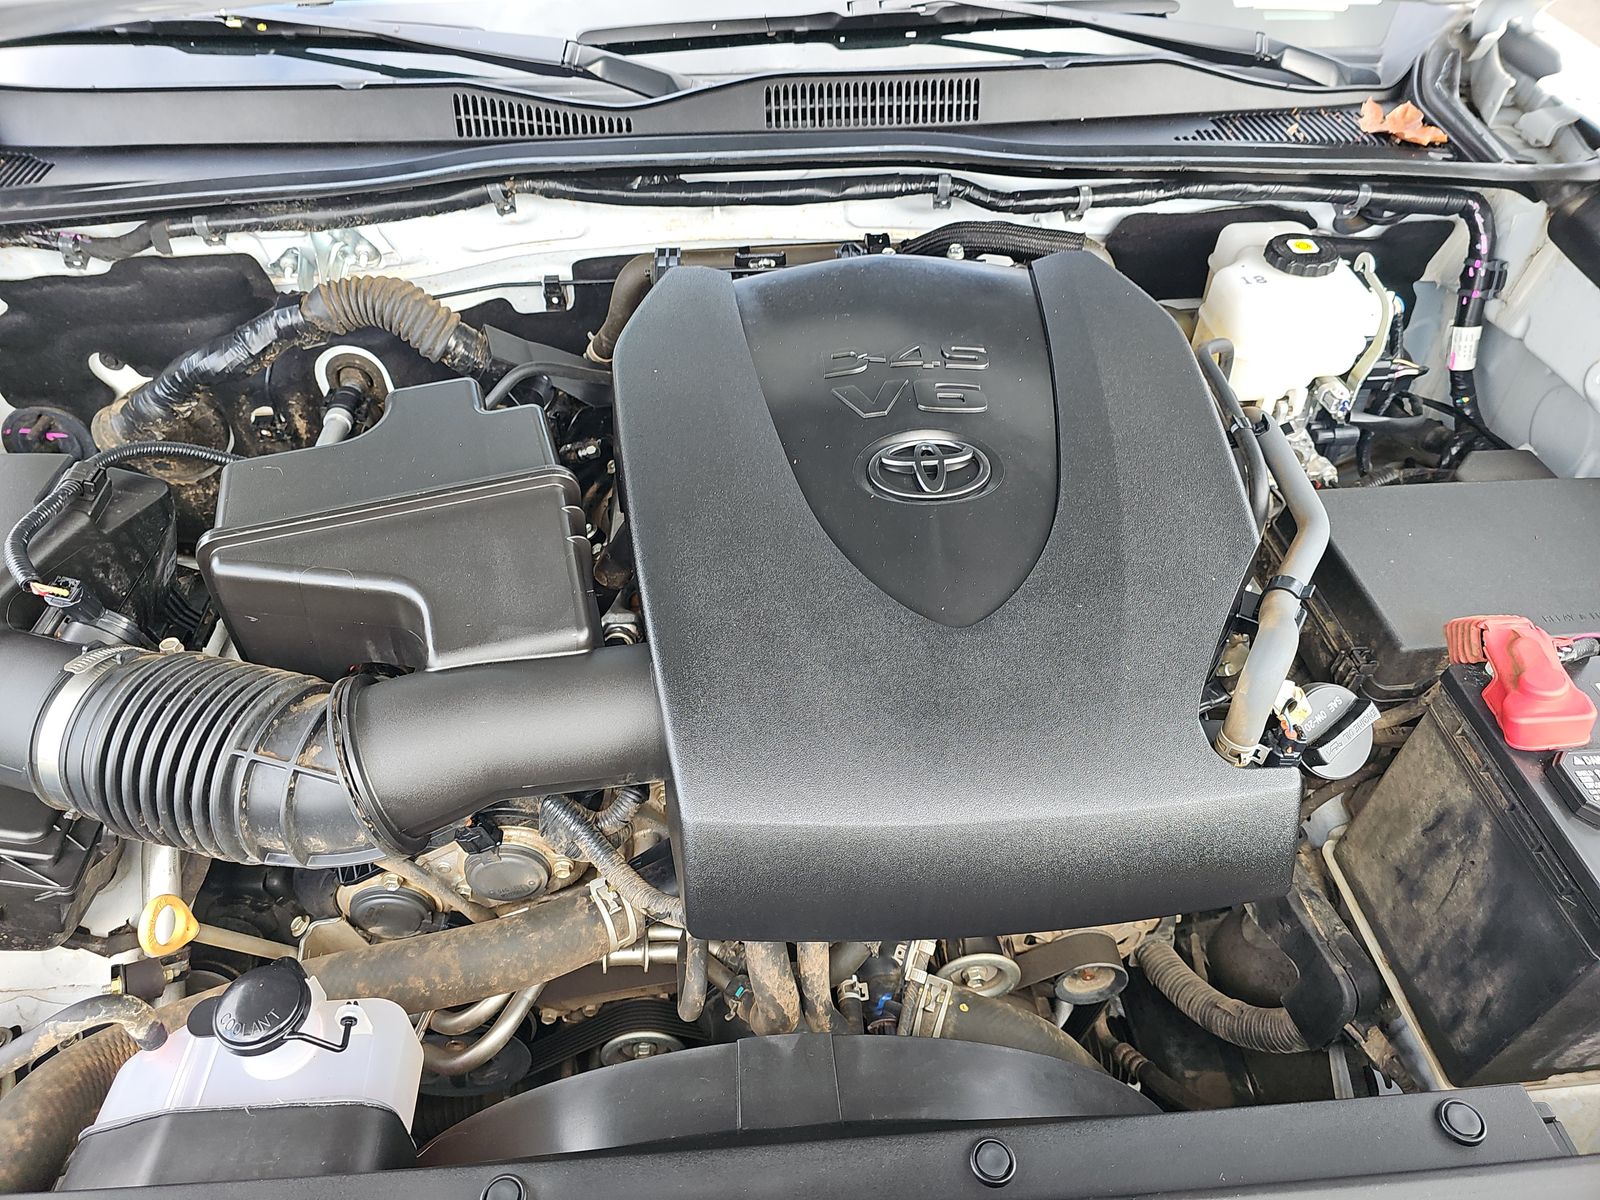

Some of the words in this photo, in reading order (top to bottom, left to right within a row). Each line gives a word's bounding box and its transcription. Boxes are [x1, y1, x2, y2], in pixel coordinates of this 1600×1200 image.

[831, 378, 989, 420] V6
[1327, 695, 1343, 713] SAE
[1304, 709, 1328, 732] 0W-20
[220, 1008, 281, 1037] COOLANT
